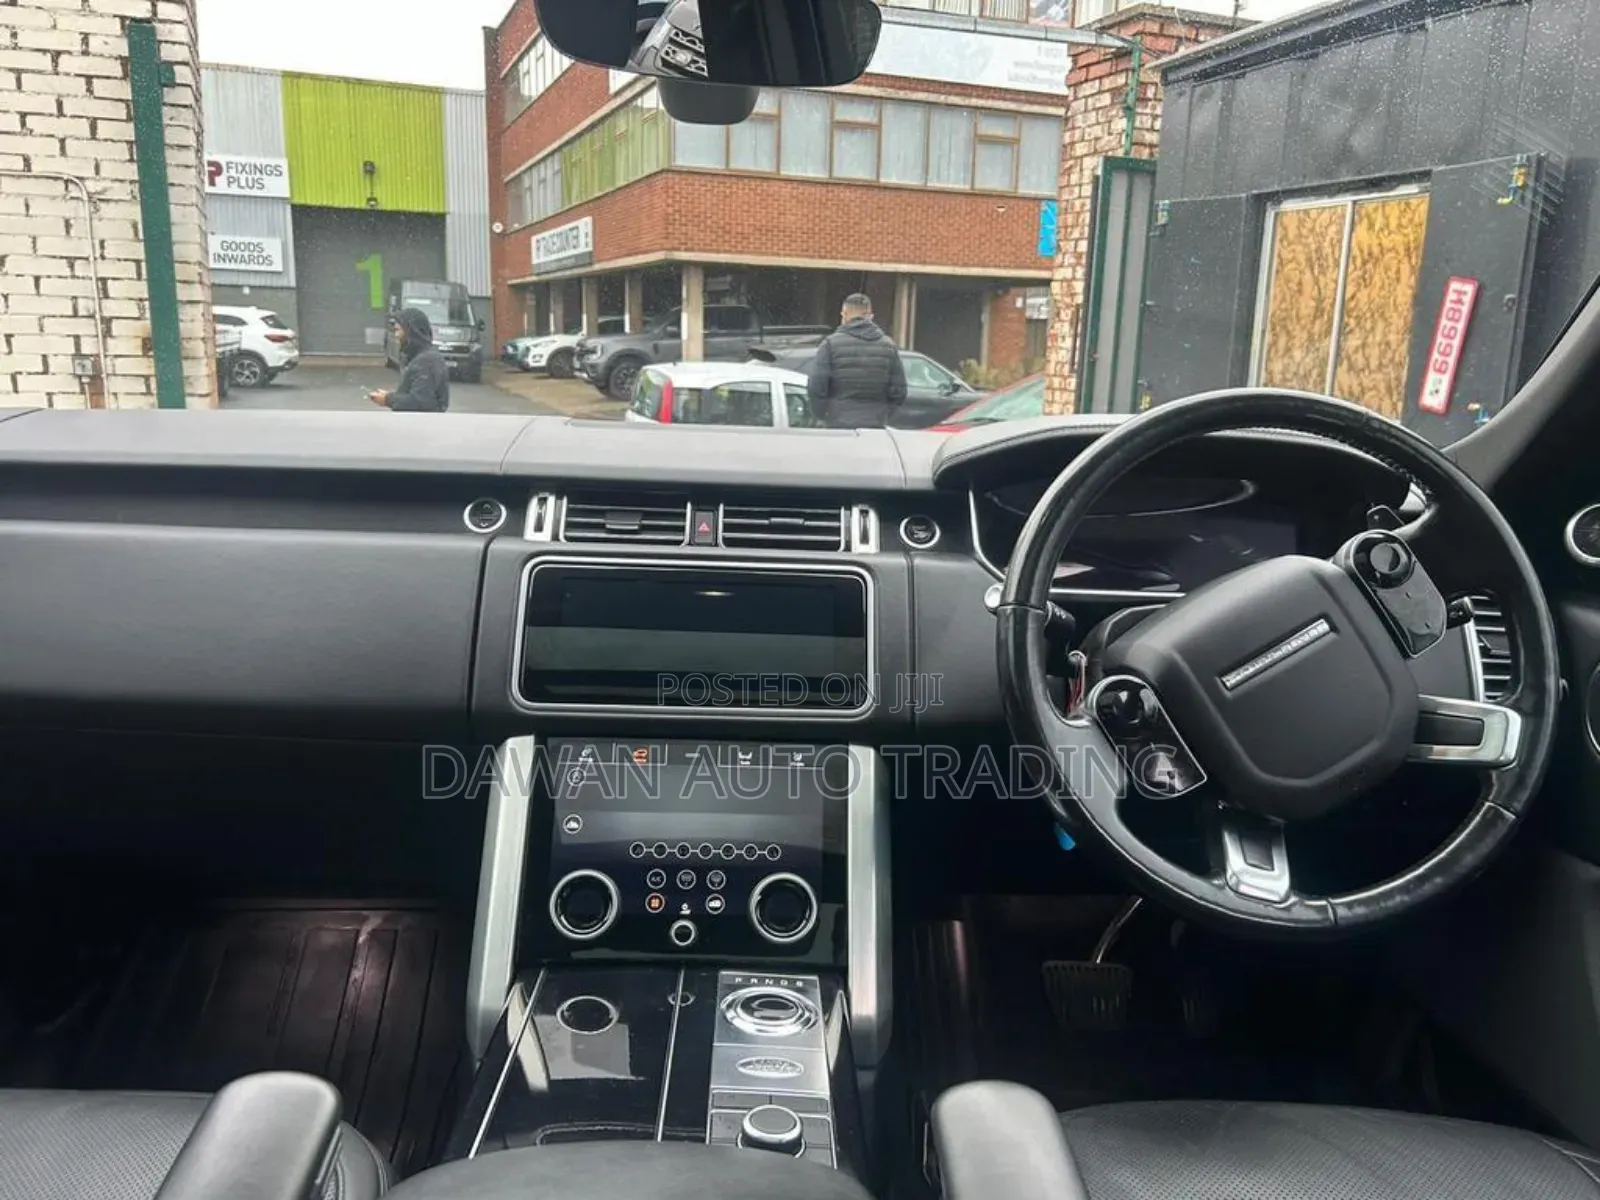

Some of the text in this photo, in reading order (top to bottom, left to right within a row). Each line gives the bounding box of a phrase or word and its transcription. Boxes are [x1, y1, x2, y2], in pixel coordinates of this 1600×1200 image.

[225, 161, 284, 177] FIXINGS
[226, 175, 265, 190] PLUS
[220, 240, 264, 253] GOODS
[212, 251, 273, 266] INWARDS
[355, 252, 384, 308] 1
[1432, 288, 1468, 375] H8999
